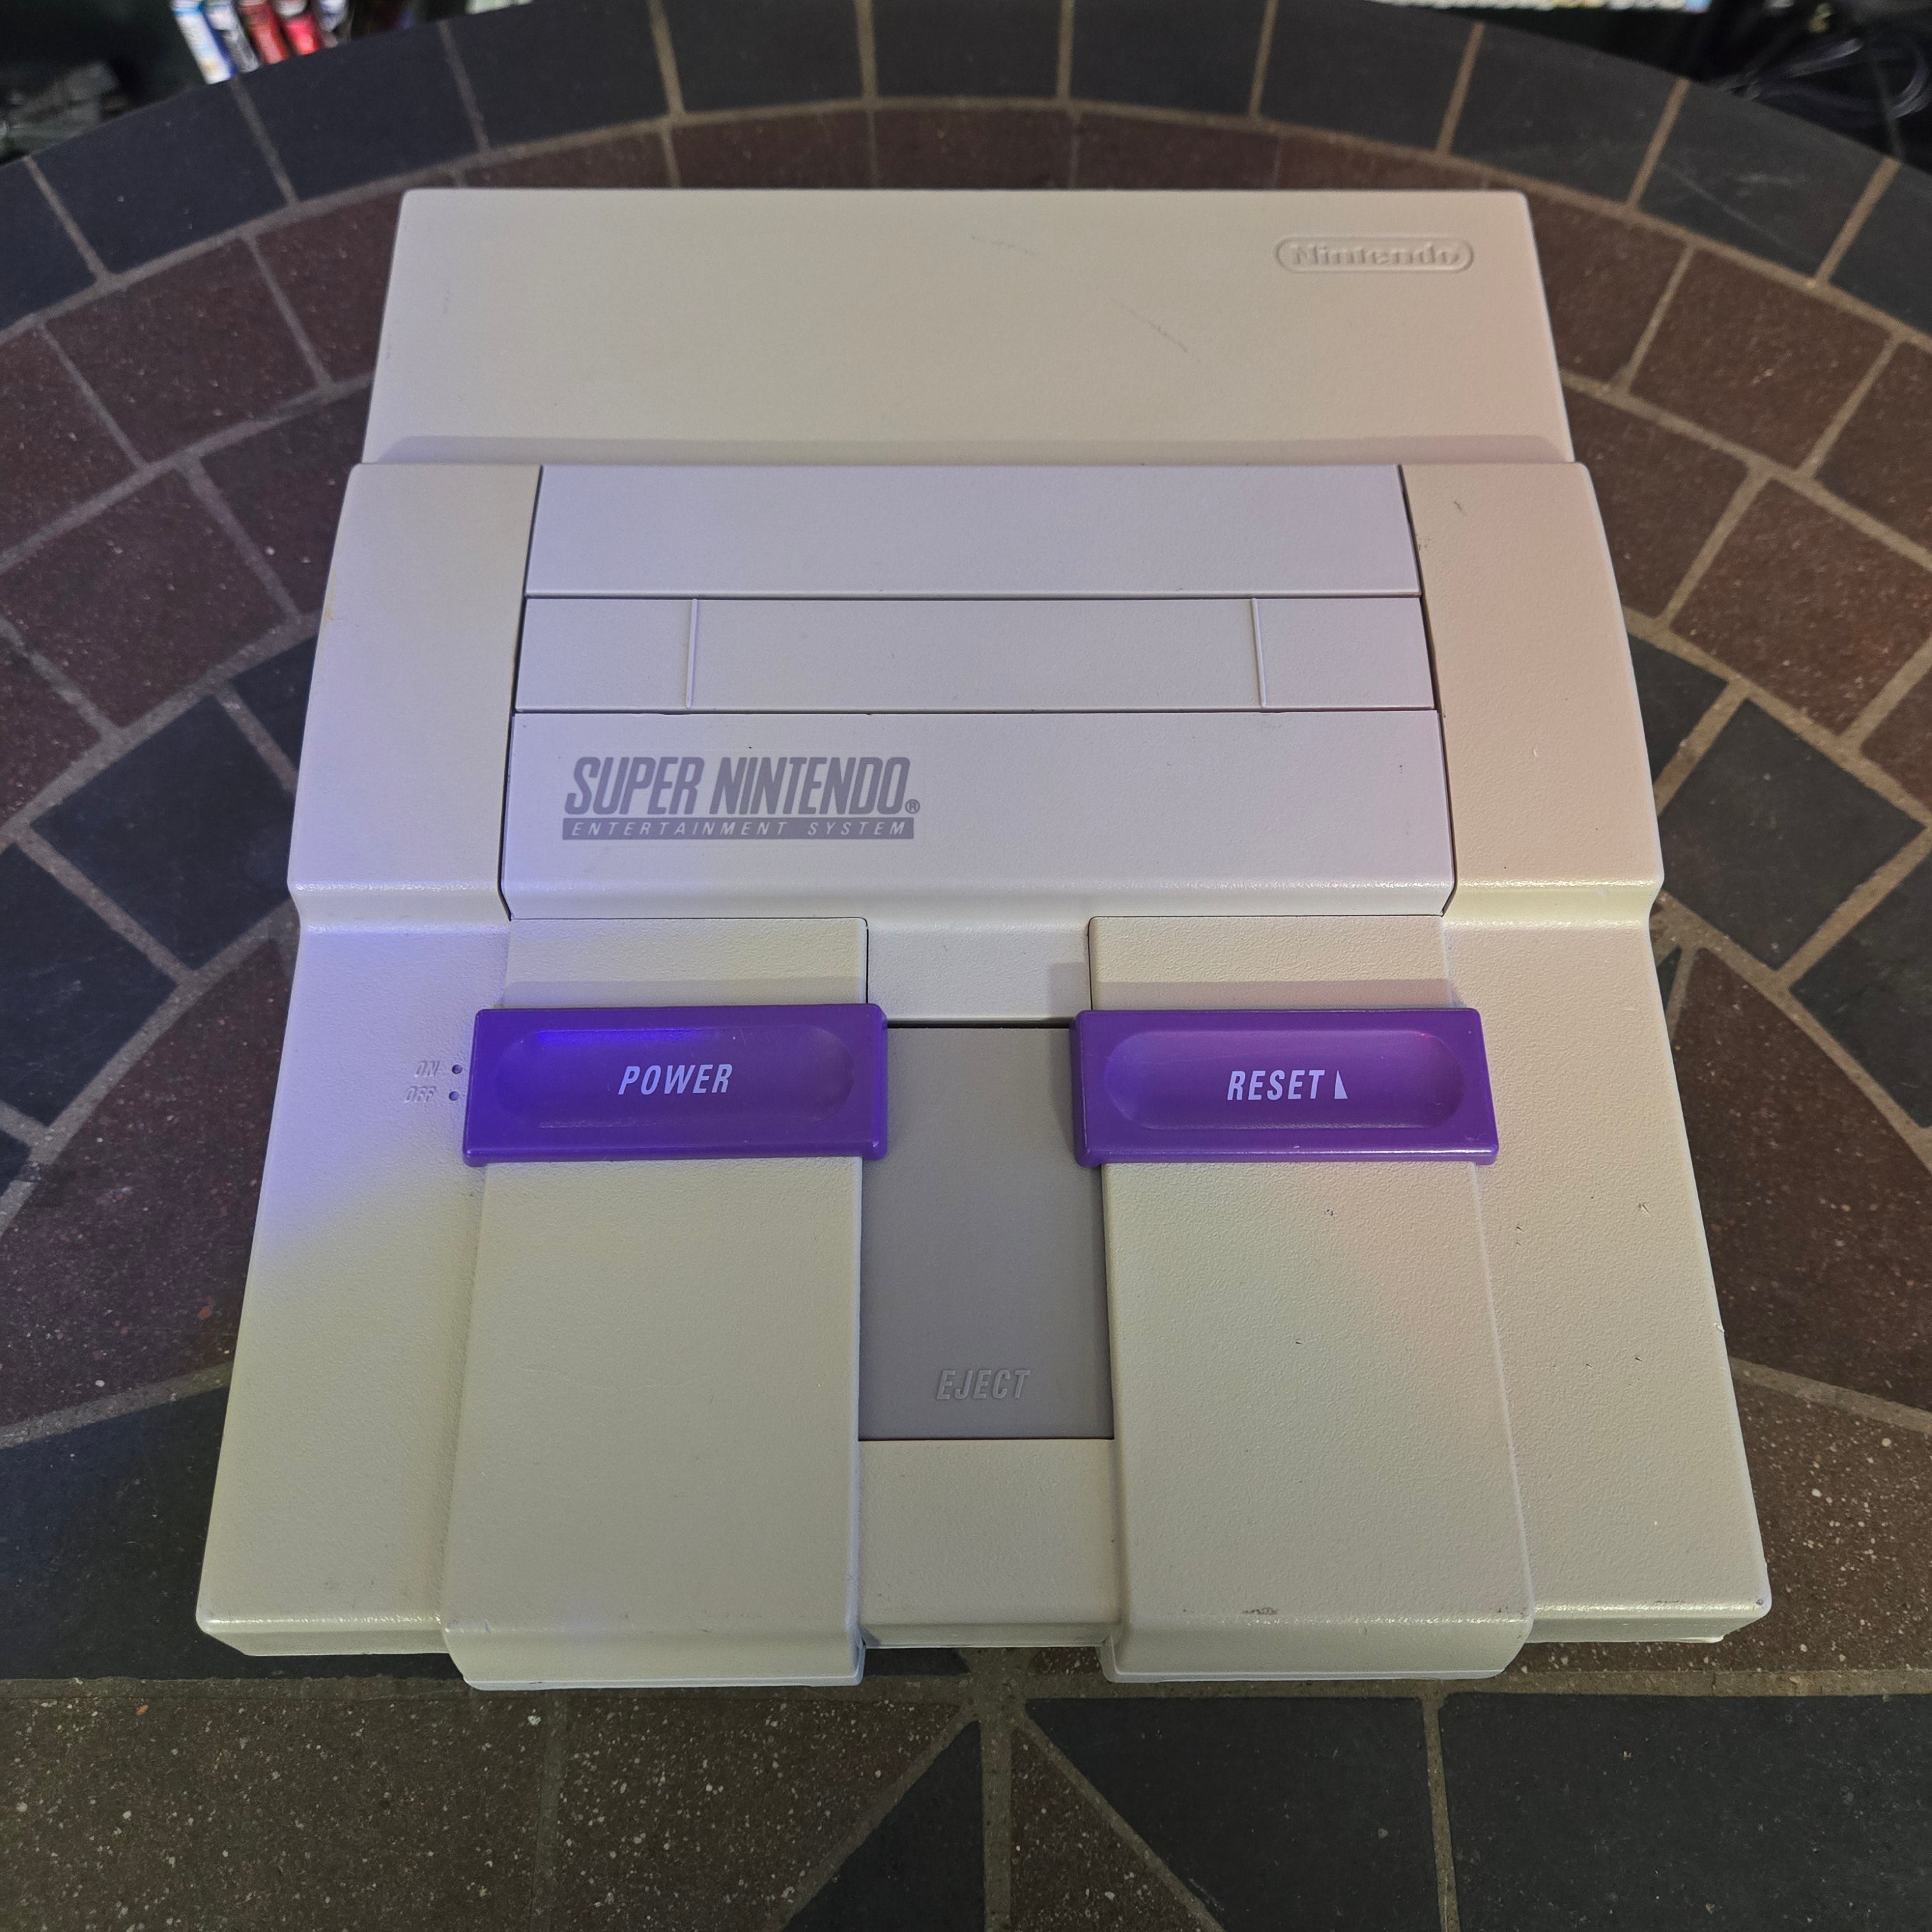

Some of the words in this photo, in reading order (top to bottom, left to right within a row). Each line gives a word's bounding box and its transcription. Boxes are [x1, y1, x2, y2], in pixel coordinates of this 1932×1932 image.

[1290, 241, 1461, 266] Nintendo
[564, 756, 704, 816] SUPER
[571, 821, 788, 837] ENTERTAINMENT
[807, 821, 906, 836] SYSTEM
[414, 1061, 440, 1078] ON
[618, 1063, 733, 1096] POWER
[404, 1085, 436, 1104] OFF
[1227, 1069, 1326, 1101] RESET
[936, 1368, 1031, 1400] EJECT
